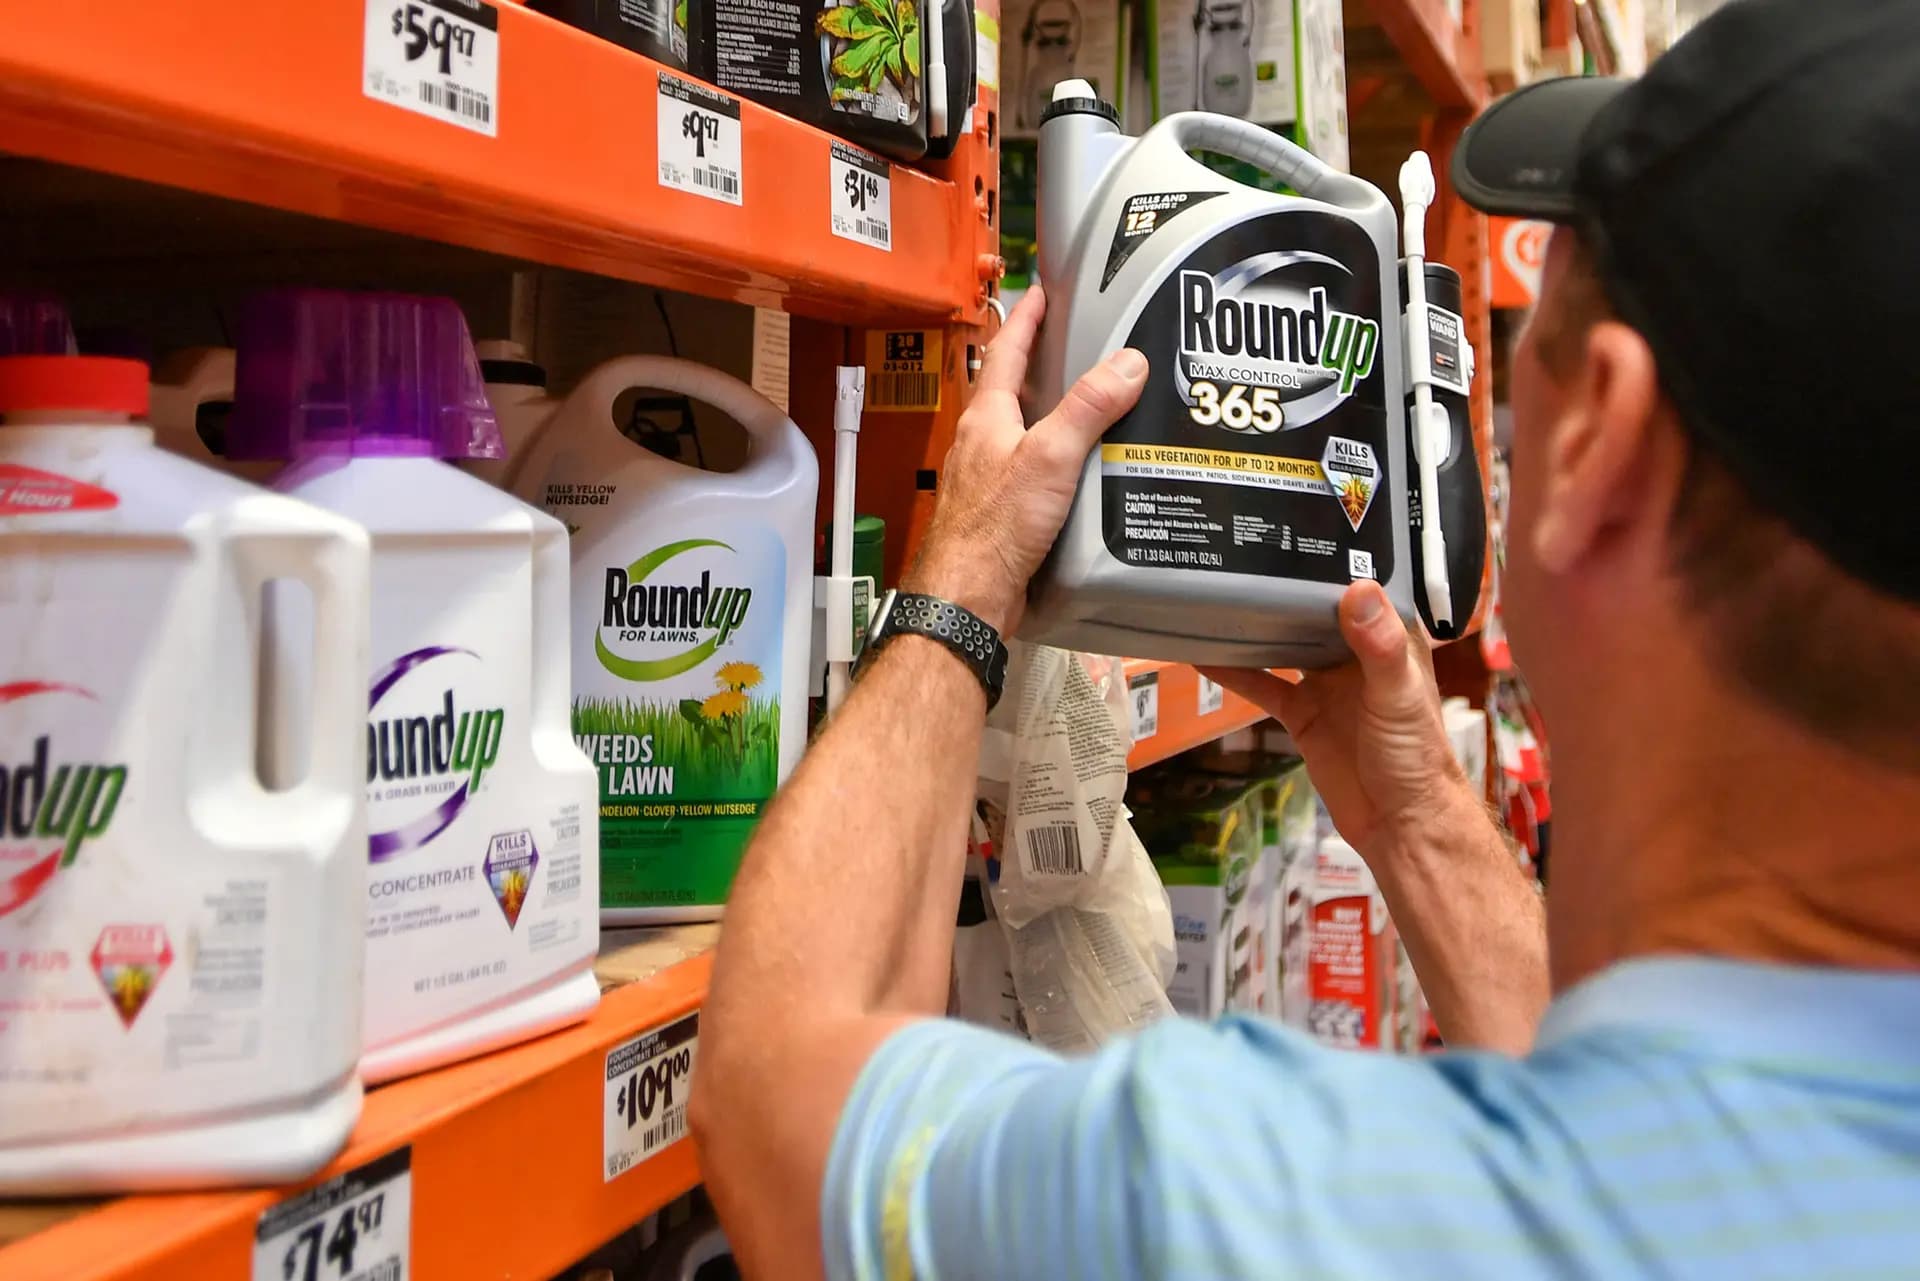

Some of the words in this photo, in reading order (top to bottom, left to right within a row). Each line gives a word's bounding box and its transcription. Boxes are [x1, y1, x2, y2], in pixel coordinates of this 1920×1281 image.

[1129, 202, 1171, 213] PREVENTS
[1131, 195, 1160, 206] KILLS
[1161, 193, 1188, 203] AND
[1125, 211, 1157, 231] 12
[1181, 270, 1379, 396] Roundup
[1430, 319, 1457, 339] WAND
[1191, 363, 1227, 378] MAX
[1229, 367, 1300, 387] CONTROL
[1189, 380, 1284, 433] 365
[1335, 441, 1368, 458] KILLS
[1125, 448, 1151, 461] KILLS
[1154, 451, 1210, 465] VEGETATION
[1214, 455, 1231, 466] FOR
[1235, 457, 1247, 469] UP
[1251, 459, 1261, 470] TO
[1265, 460, 1274, 471] 12
[1277, 462, 1316, 477] MONTHS
[1126, 466, 1138, 474] FOR
[1140, 466, 1153, 474] USE
[1154, 467, 1164, 475] ON
[1232, 474, 1266, 484] SIDEWALKS
[1268, 477, 1281, 486] AND
[1282, 479, 1305, 489] GRAVEL
[547, 484, 574, 494] KILLS
[577, 485, 617, 494] YELLOW
[545, 495, 609, 505] NUTSEDGE!
[1125, 501, 1156, 514] CAUTION
[1127, 548, 1142, 560] NET
[1144, 549, 1158, 561] 1.33
[1160, 550, 1174, 562] GAL
[1175, 551, 1189, 564] (170
[1190, 551, 1199, 564] FL
[603, 568, 752, 647] Roundup
[619, 631, 646, 641] FOR
[608, 767, 674, 795] LAWN
[644, 805, 675, 817] CLOVER
[679, 804, 712, 816] YELLOW
[714, 803, 757, 815] NUTSEDGE
[496, 834, 527, 851] KILLS
[369, 865, 475, 898] CONCENTRATE
